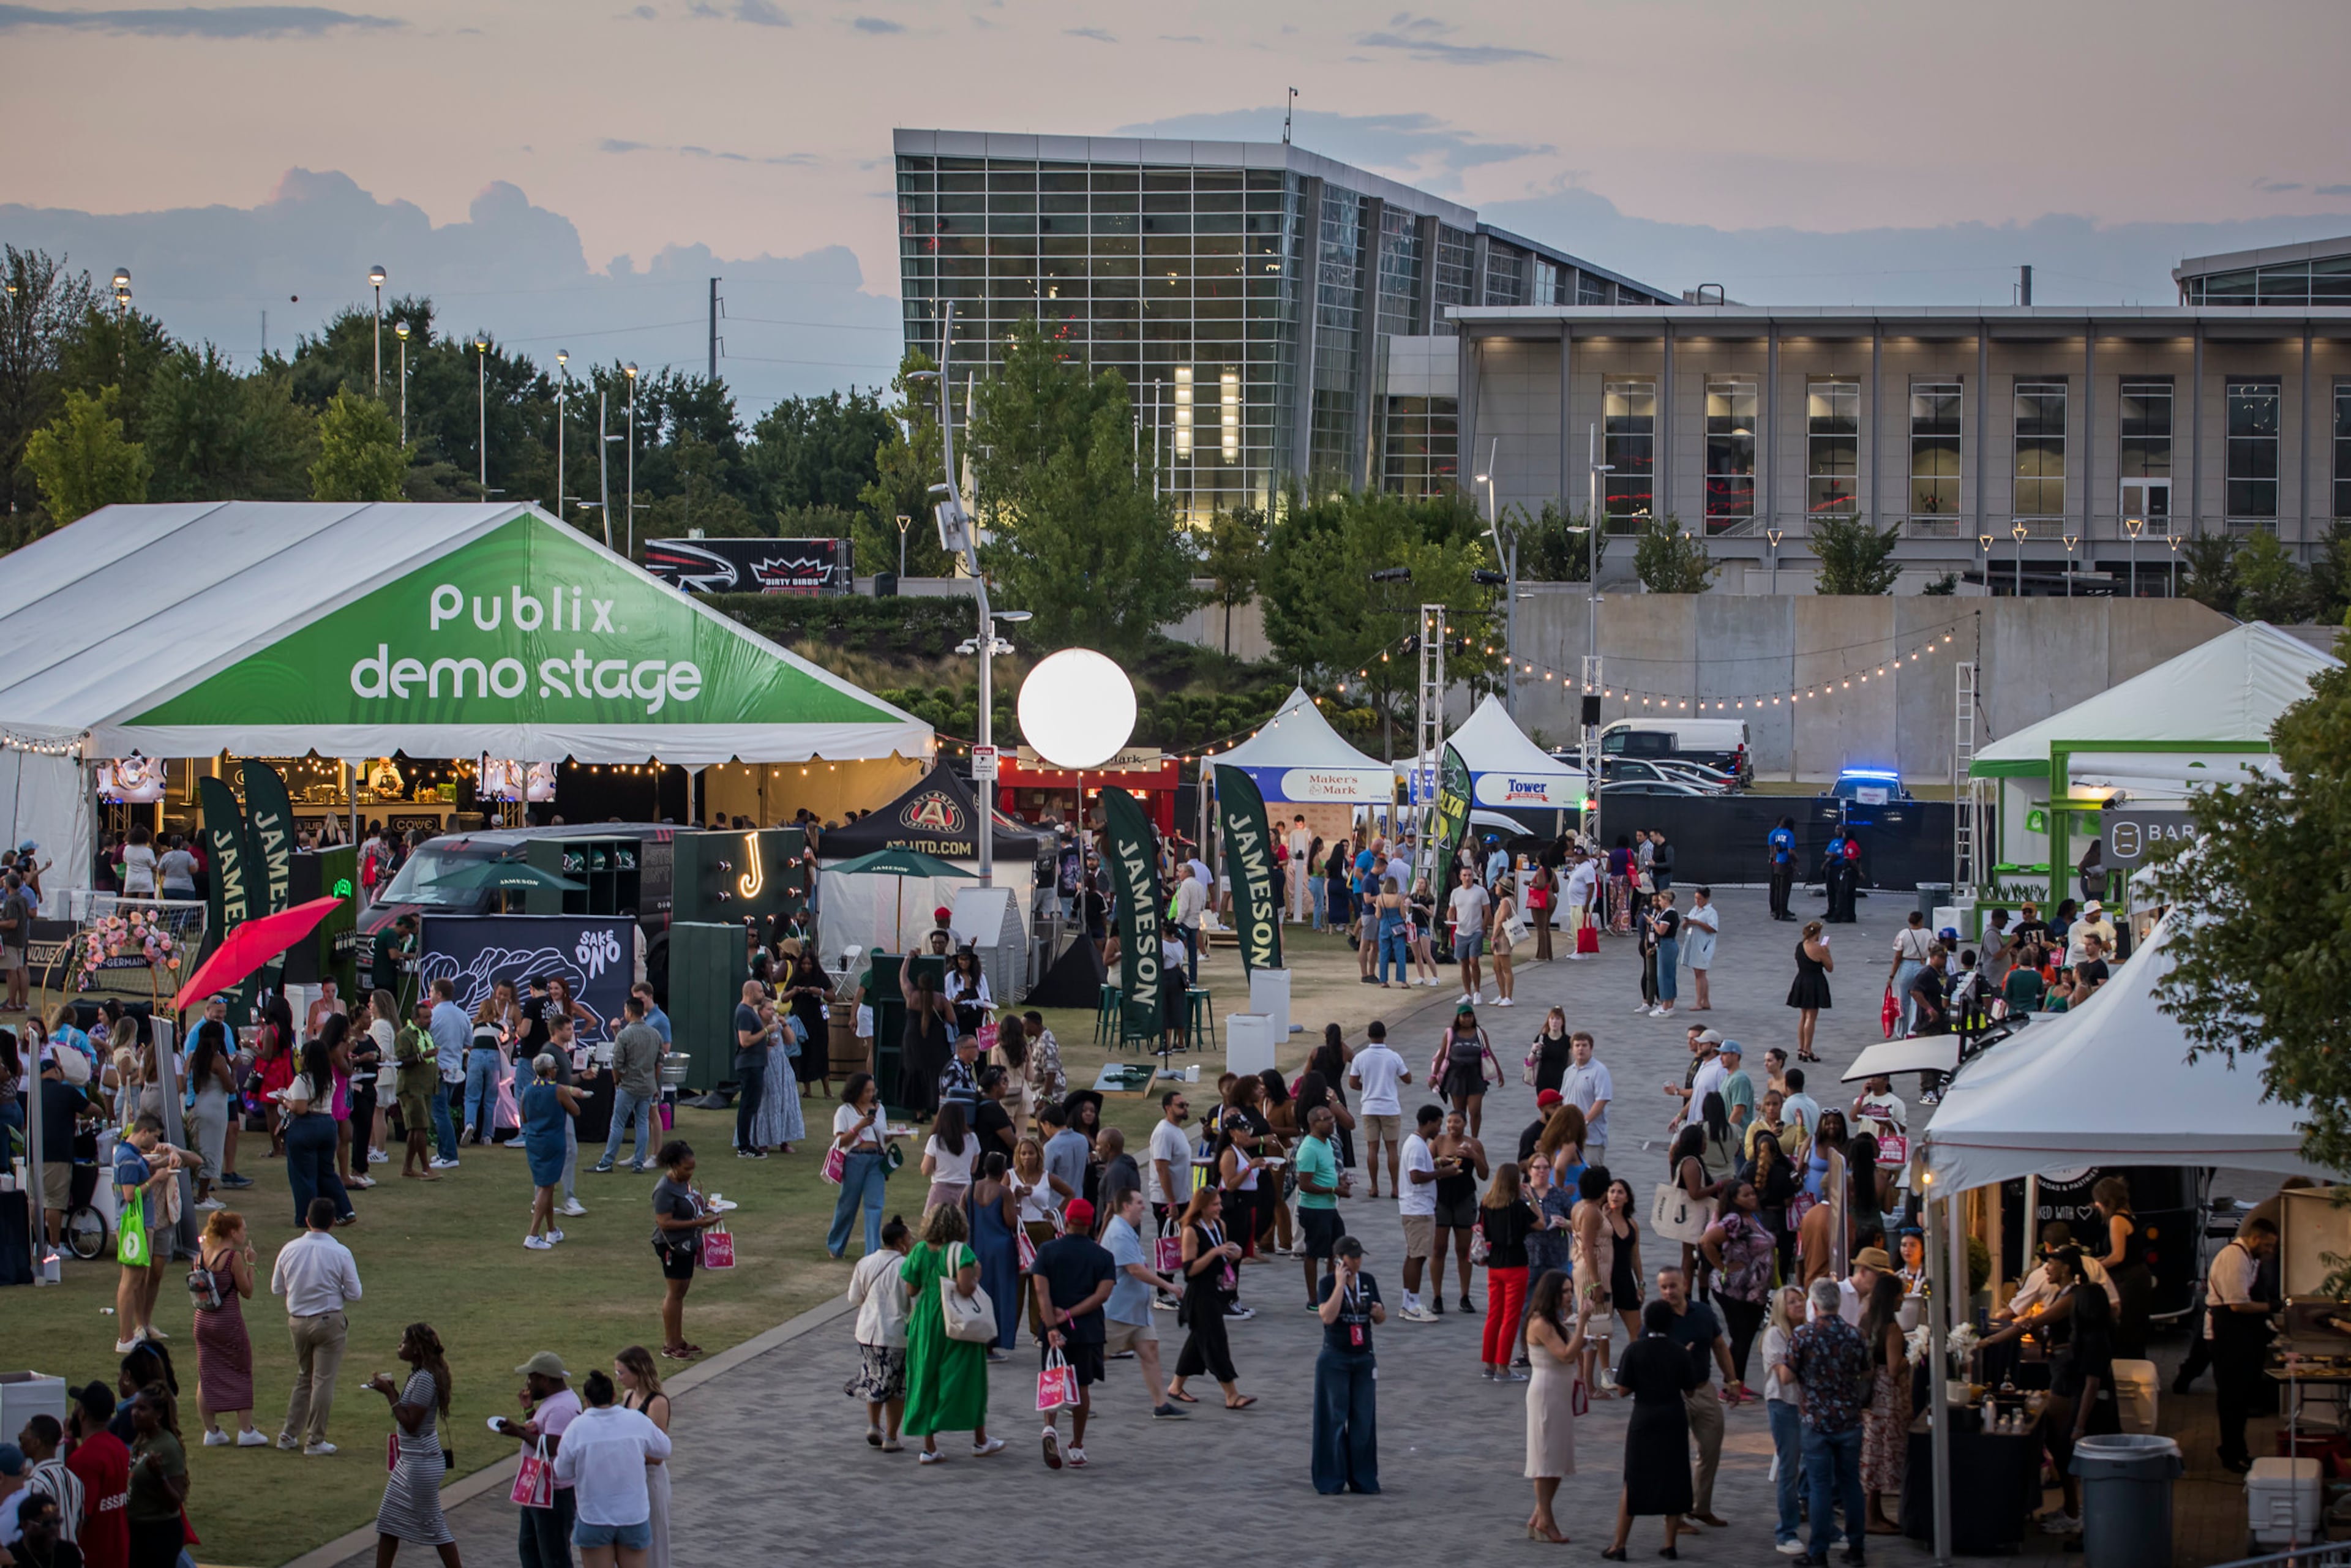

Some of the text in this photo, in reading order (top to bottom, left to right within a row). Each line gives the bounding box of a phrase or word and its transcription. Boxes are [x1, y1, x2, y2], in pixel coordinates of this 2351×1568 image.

[430, 583, 615, 633] Publix
[350, 643, 703, 715] demo stage
[1309, 775, 1358, 784] Maker's
[1323, 786, 1357, 795] Mark
[1508, 778, 1547, 793] Tower
[740, 830, 763, 899] J
[1229, 812, 1273, 968] JAMESON
[580, 929, 614, 945] SAKE
[1118, 839, 1157, 1008] JAMESON
[575, 940, 621, 980] ONO
